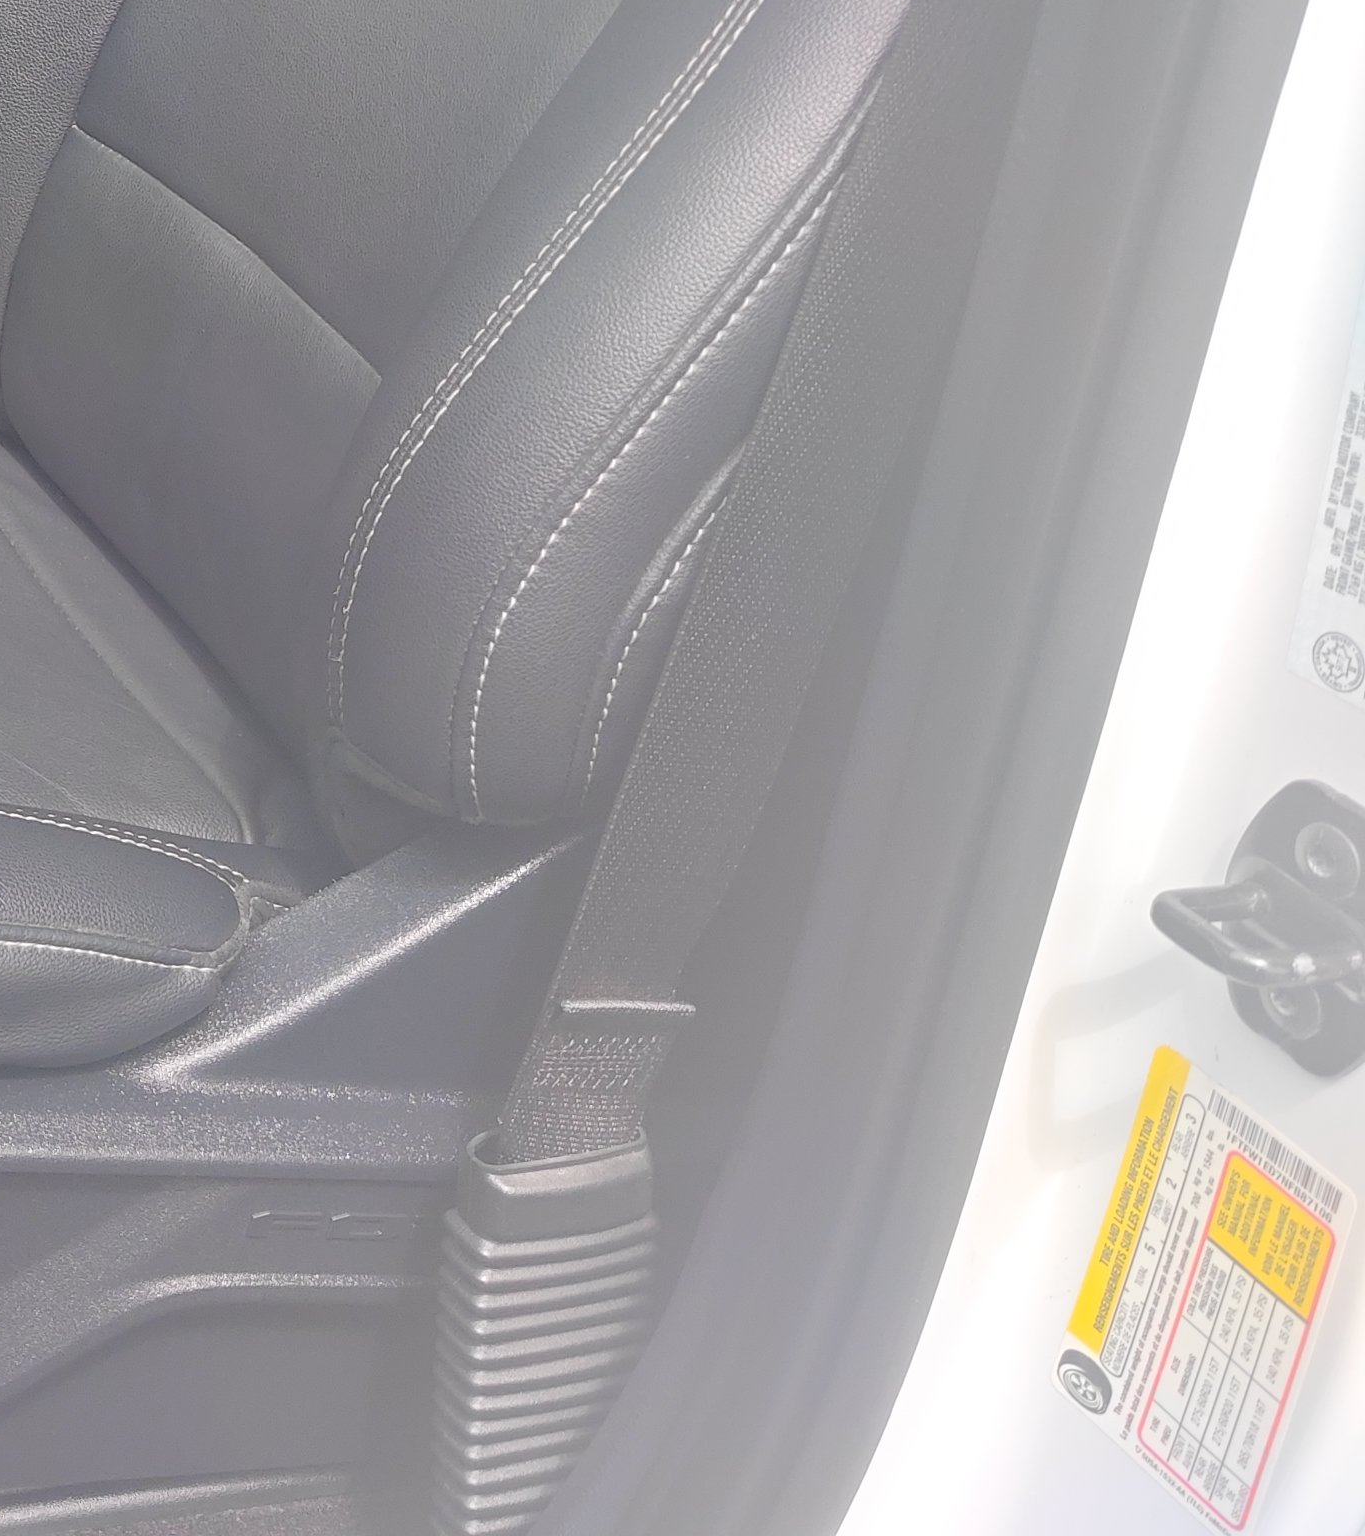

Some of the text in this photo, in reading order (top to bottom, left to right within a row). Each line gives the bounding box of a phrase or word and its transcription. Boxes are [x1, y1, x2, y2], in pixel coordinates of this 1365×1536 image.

[1185, 1111, 1197, 1125] 3
[1099, 1114, 1154, 1268] TIRE AND LOADING INFORMATION
[1165, 1175, 1177, 1189] 2
[1226, 1178, 1251, 1237] MANUAL FOR
[1092, 1085, 1178, 1334] RENSEIGNEMENTS SUR LES PNEUS ET LE CHARGEMENT
[1215, 1208, 1228, 1229] SEE
[1237, 1189, 1261, 1243] ADDITIONAL
[1247, 1193, 1274, 1257] INFORMATION
[1144, 1241, 1155, 1255] 5
[1260, 1251, 1274, 1276] VOIR
[1271, 1201, 1291, 1241] MANUEL
[1283, 1261, 1299, 1289] POUR
[1291, 1237, 1307, 1265] PLUS
[1291, 1225, 1326, 1307] RENSEIGNEMENTS
[1230, 1287, 1242, 1304] 35
[1252, 1306, 1264, 1323] 35
[1278, 1328, 1290, 1345] 35
